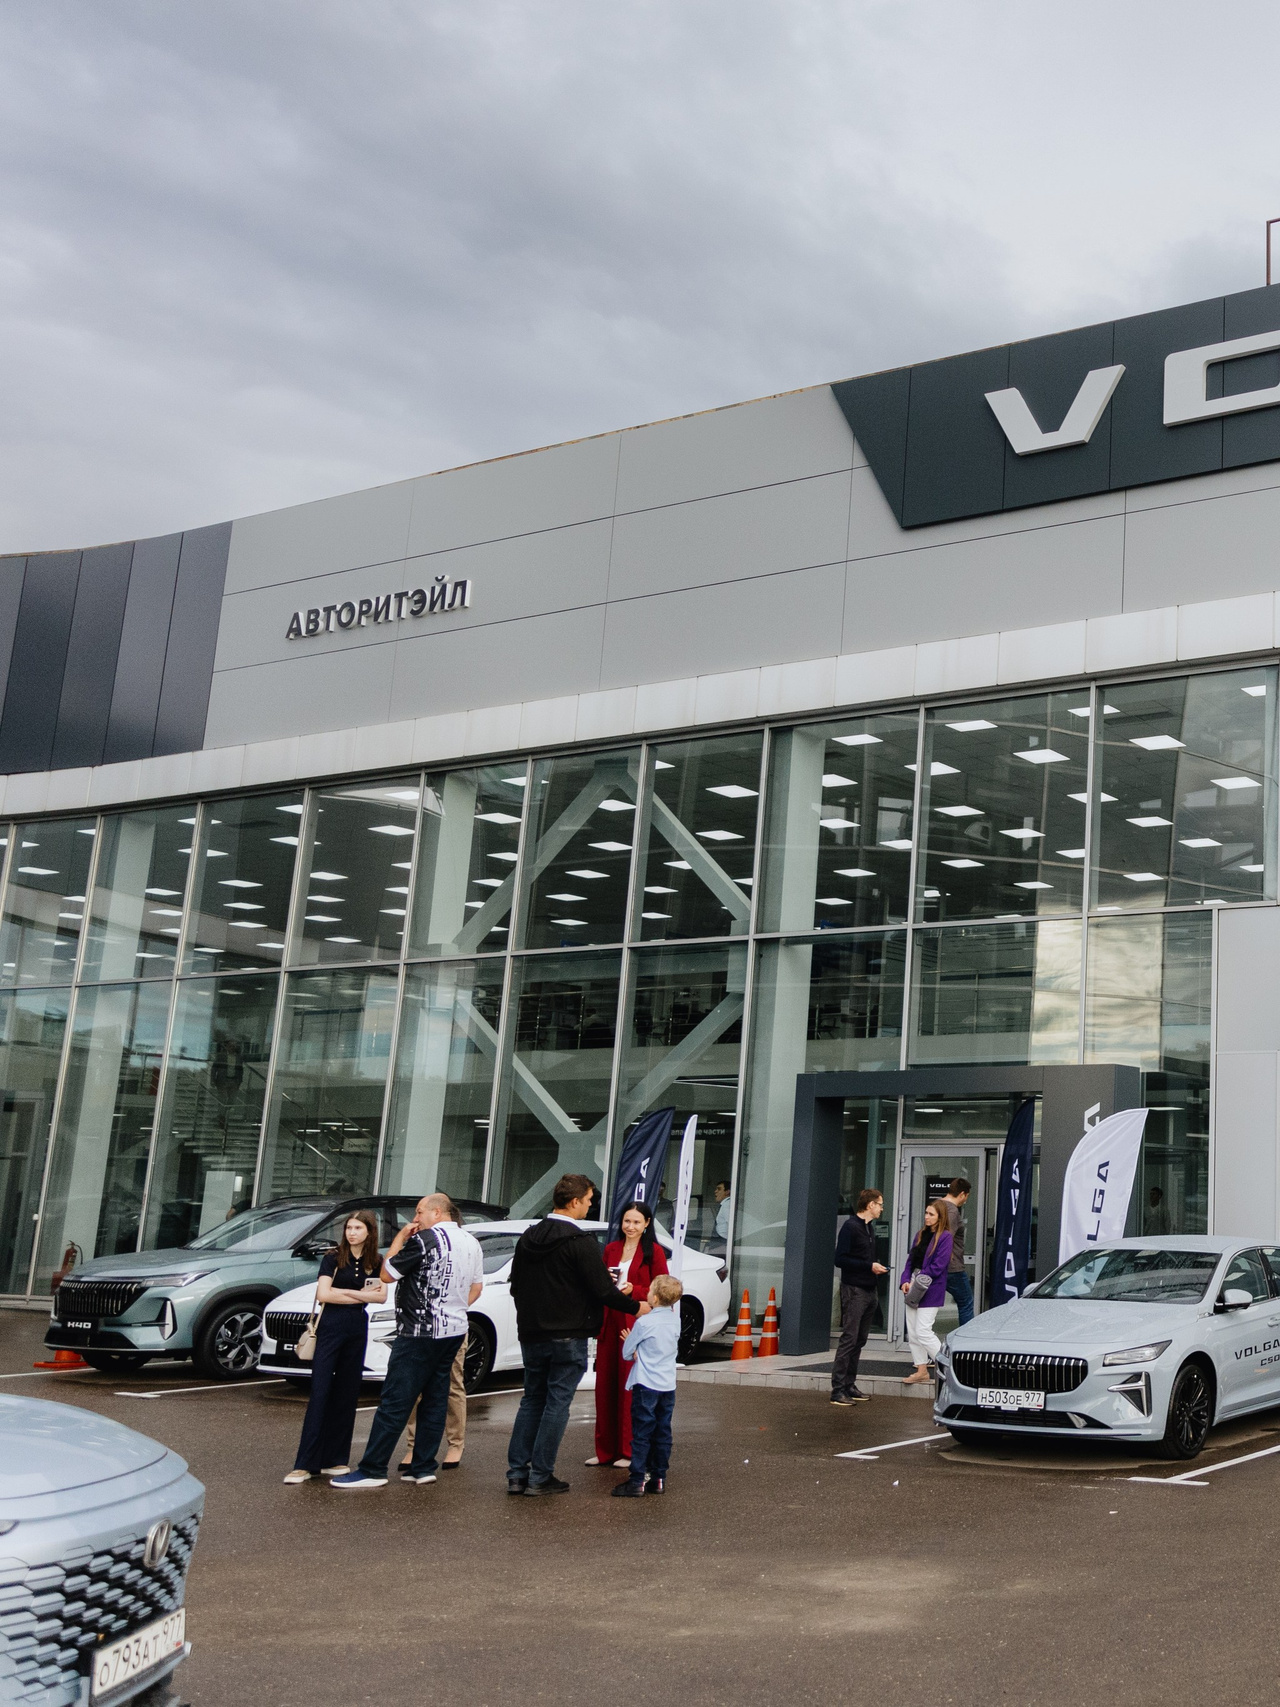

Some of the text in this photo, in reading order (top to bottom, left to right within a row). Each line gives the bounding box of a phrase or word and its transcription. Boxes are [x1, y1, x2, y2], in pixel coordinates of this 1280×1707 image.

[285, 574, 471, 640] АВТОРИТЭЙЛ
[703, 1128, 726, 1136] части
[1234, 1338, 1280, 1360] VOLGA
[1260, 1354, 1280, 1367] C50
[1024, 1392, 1041, 1403] 977
[163, 1613, 182, 1645] 977
